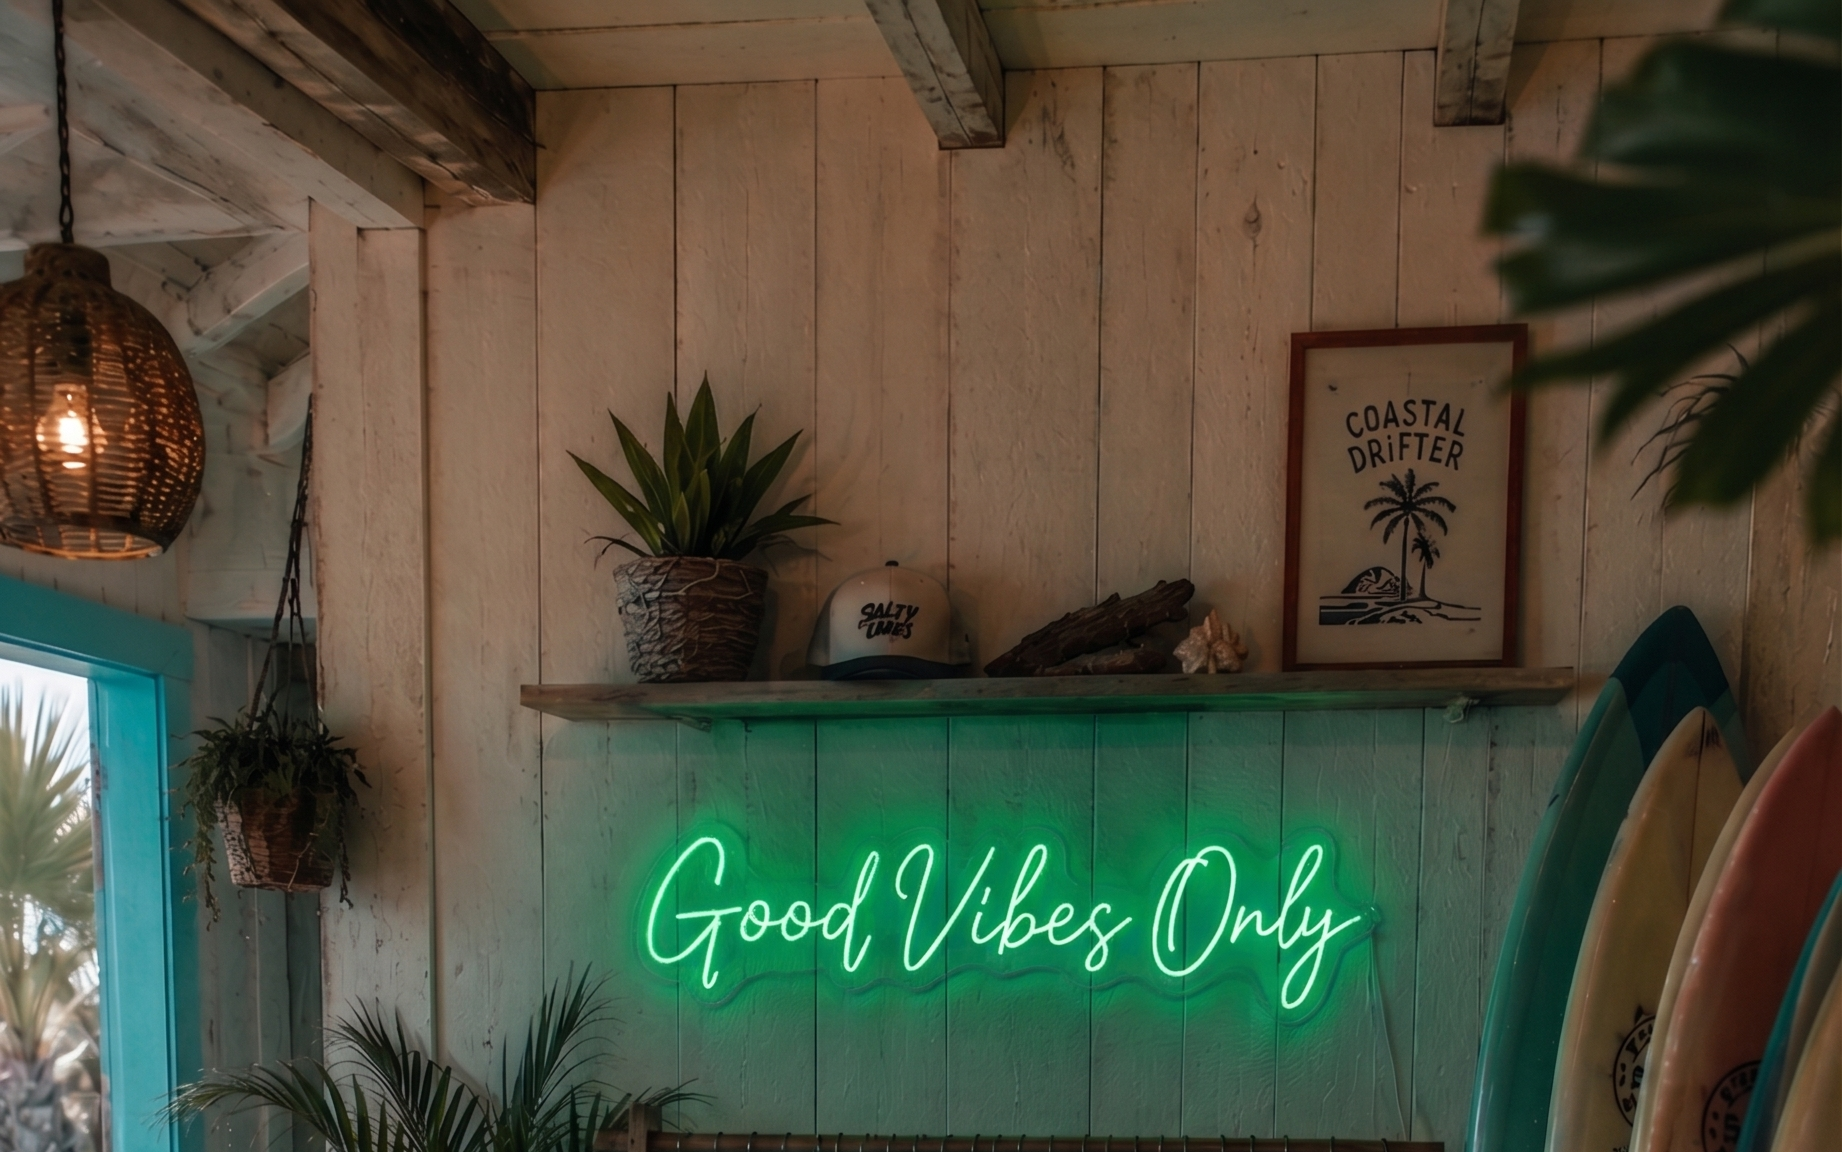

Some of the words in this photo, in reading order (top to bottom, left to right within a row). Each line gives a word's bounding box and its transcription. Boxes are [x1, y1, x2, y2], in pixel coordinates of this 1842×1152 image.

[1345, 399, 1465, 438] COASTAL
[860, 600, 920, 624] SALTY
[646, 836, 880, 989] Good
[895, 843, 1133, 972] Vibes
[1151, 844, 1362, 1010] Only
